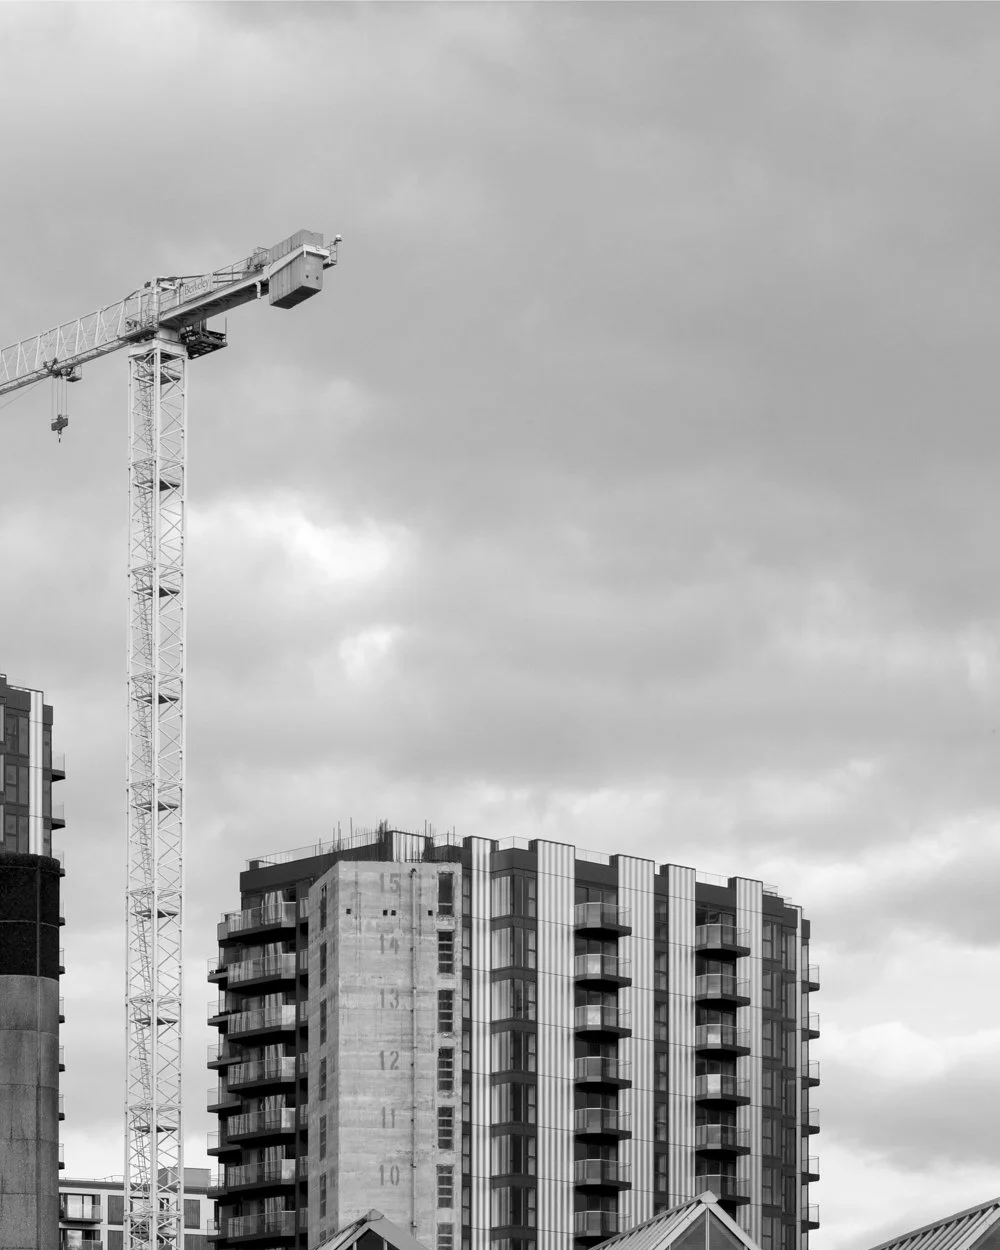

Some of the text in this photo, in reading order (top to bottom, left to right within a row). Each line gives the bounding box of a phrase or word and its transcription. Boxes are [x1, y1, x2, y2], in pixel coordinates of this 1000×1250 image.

[184, 277, 210, 296] Berkeley
[379, 873, 400, 893] 15
[380, 933, 399, 955] 14
[379, 988, 400, 1009] 13
[379, 1050, 400, 1071] 12
[381, 1107, 396, 1129] 11
[379, 1164, 400, 1186] 10
